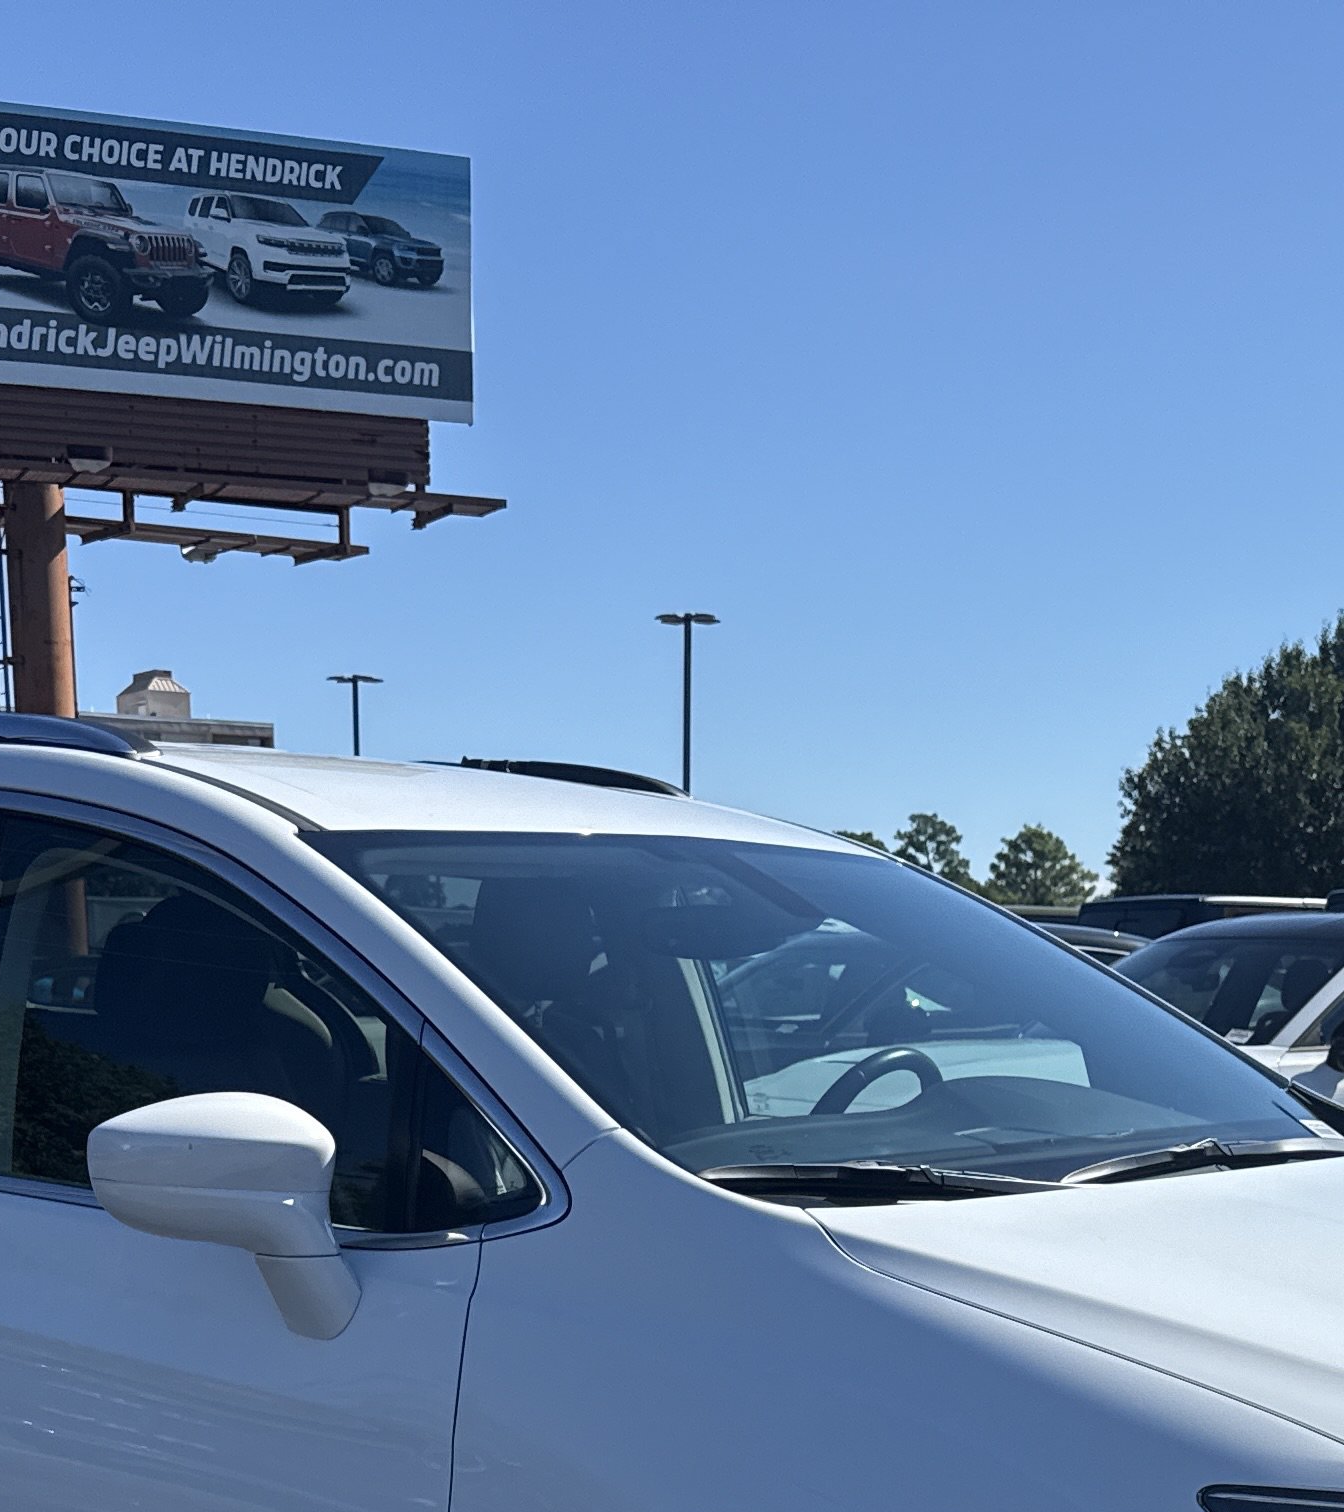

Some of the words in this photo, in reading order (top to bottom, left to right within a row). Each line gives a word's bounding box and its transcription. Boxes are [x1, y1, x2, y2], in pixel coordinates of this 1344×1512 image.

[63, 134, 164, 171] CHOICE
[168, 146, 205, 175] AT
[208, 150, 344, 191] HENDRICK
